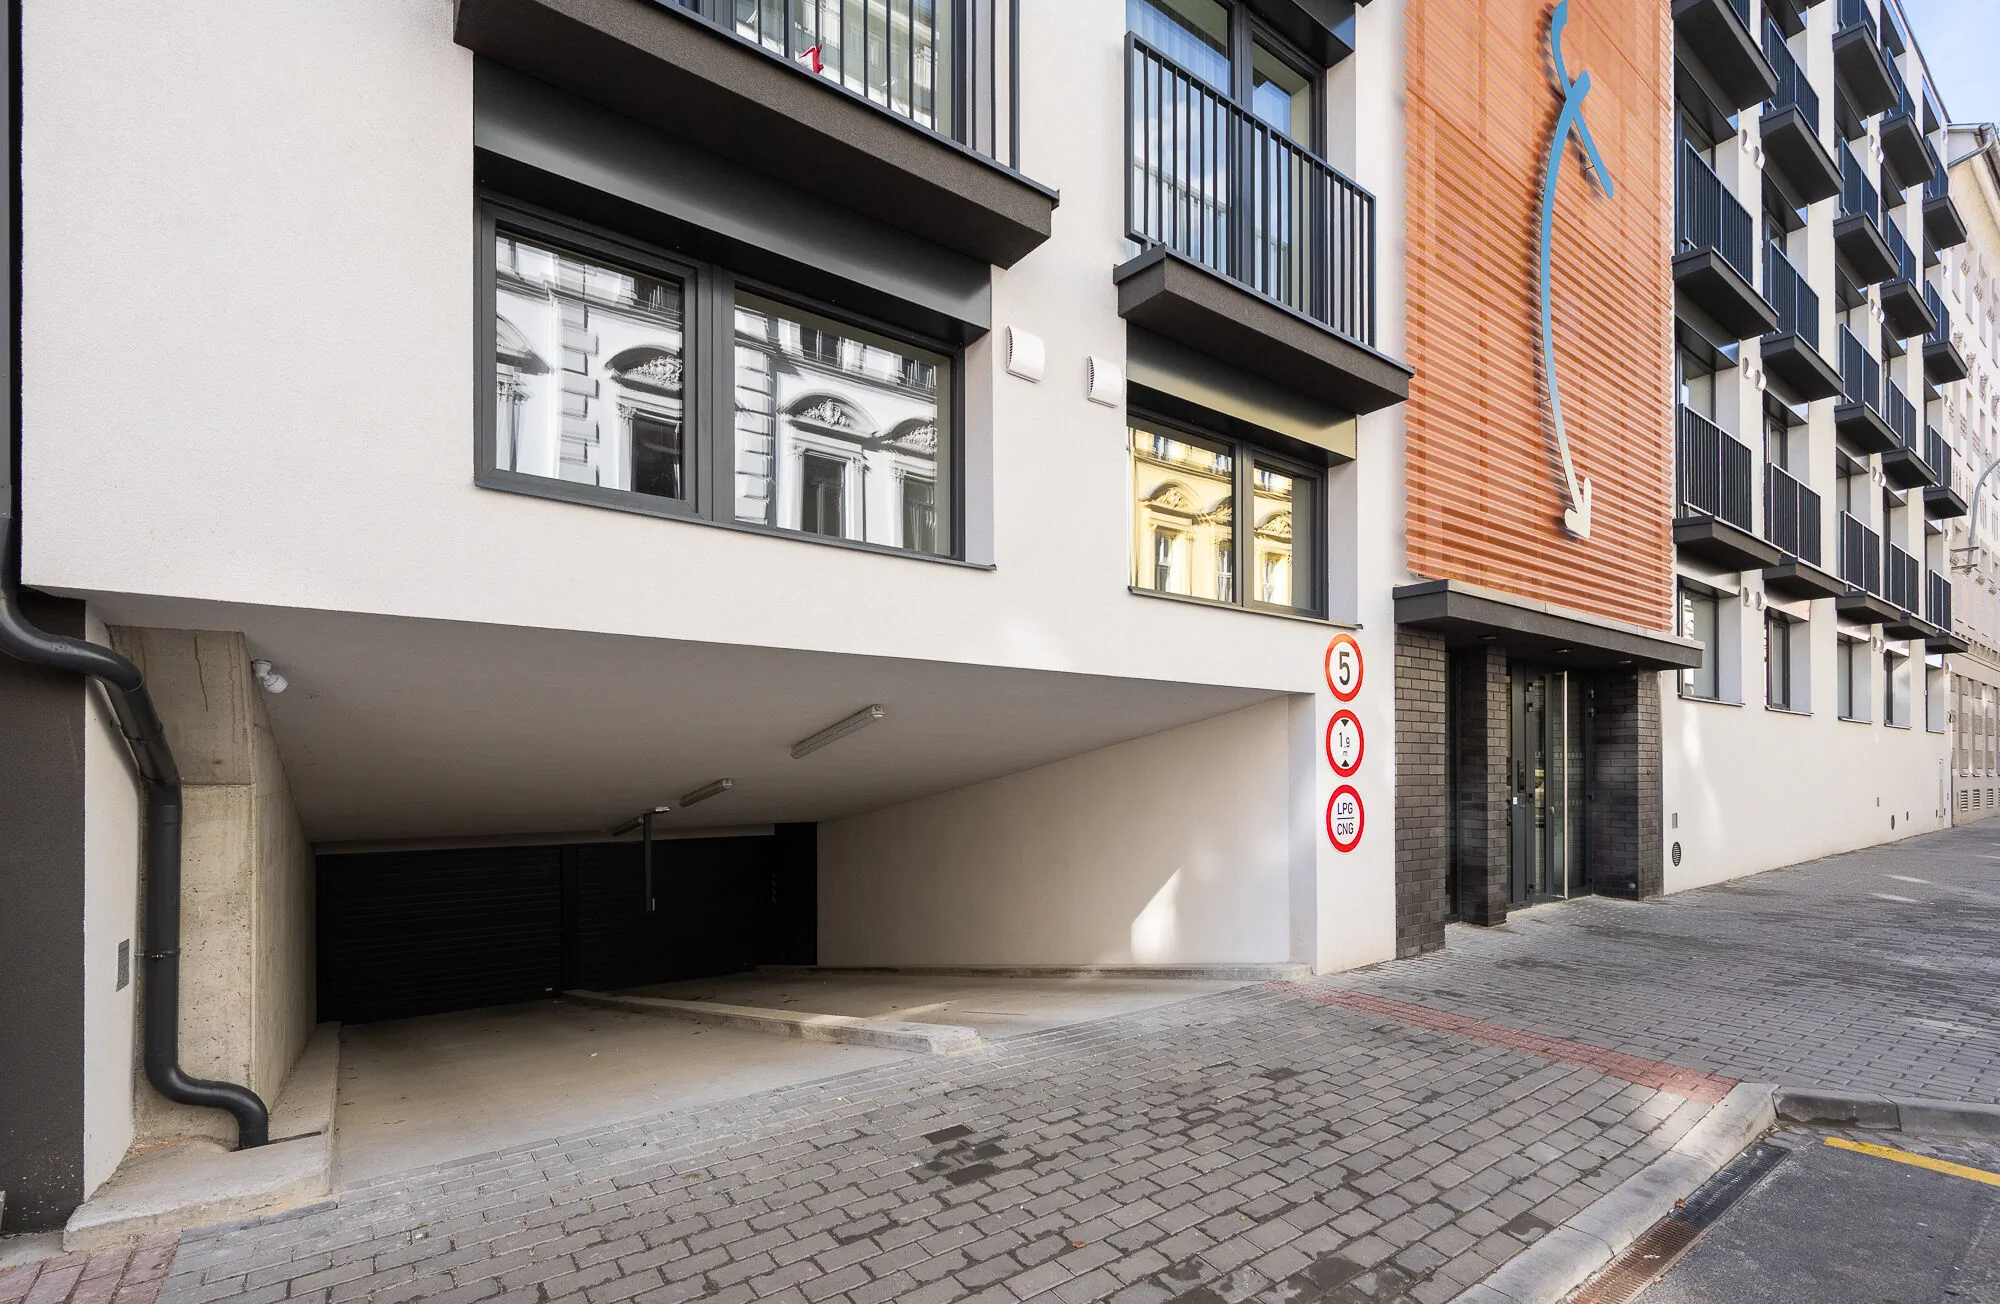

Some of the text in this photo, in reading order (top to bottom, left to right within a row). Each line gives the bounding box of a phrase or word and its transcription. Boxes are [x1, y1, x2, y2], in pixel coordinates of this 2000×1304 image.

[1339, 651, 1350, 685] 5
[1337, 802, 1353, 815] LPG
[1337, 822, 1354, 836] CNG
